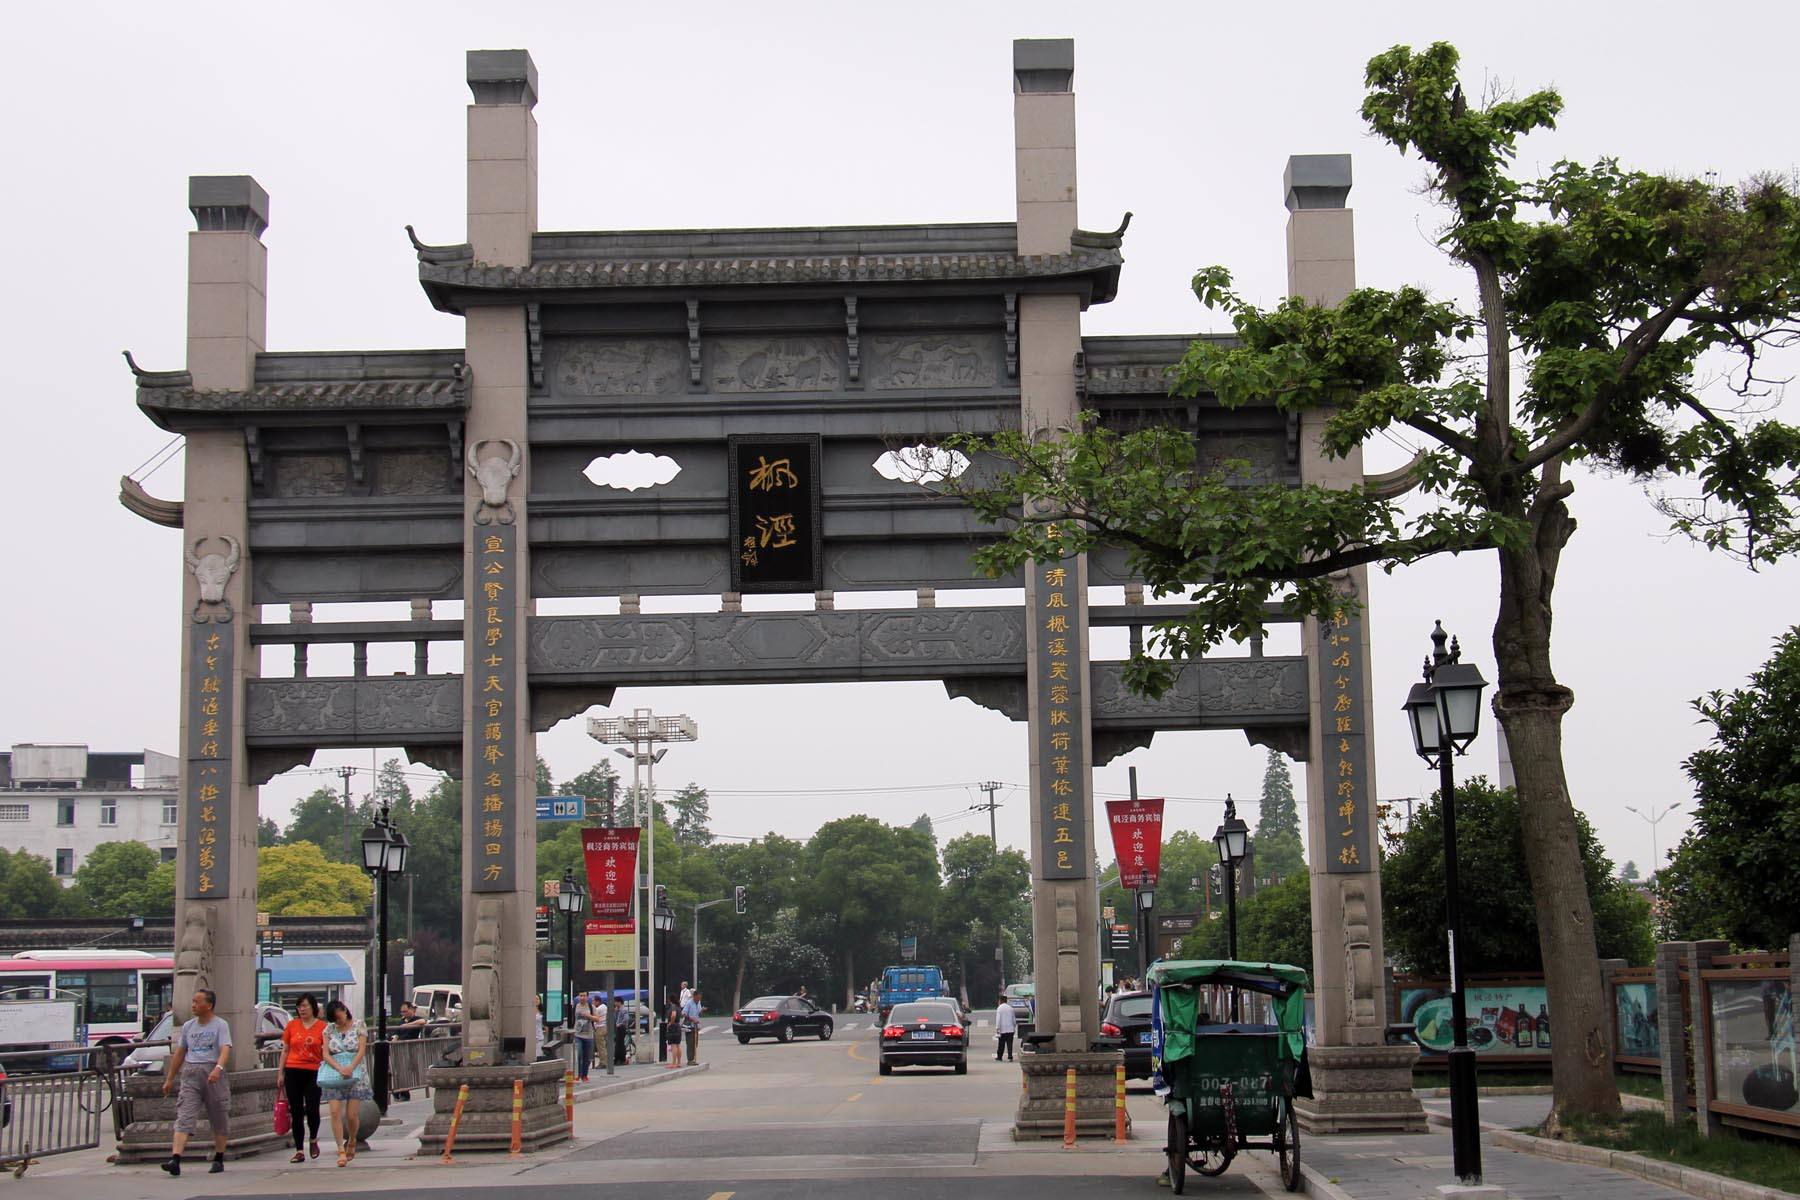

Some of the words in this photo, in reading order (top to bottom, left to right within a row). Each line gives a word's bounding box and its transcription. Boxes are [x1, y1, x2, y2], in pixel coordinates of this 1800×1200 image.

[1132, 828, 1144, 866] 欢迎您
[605, 856, 617, 895] 欢迎您
